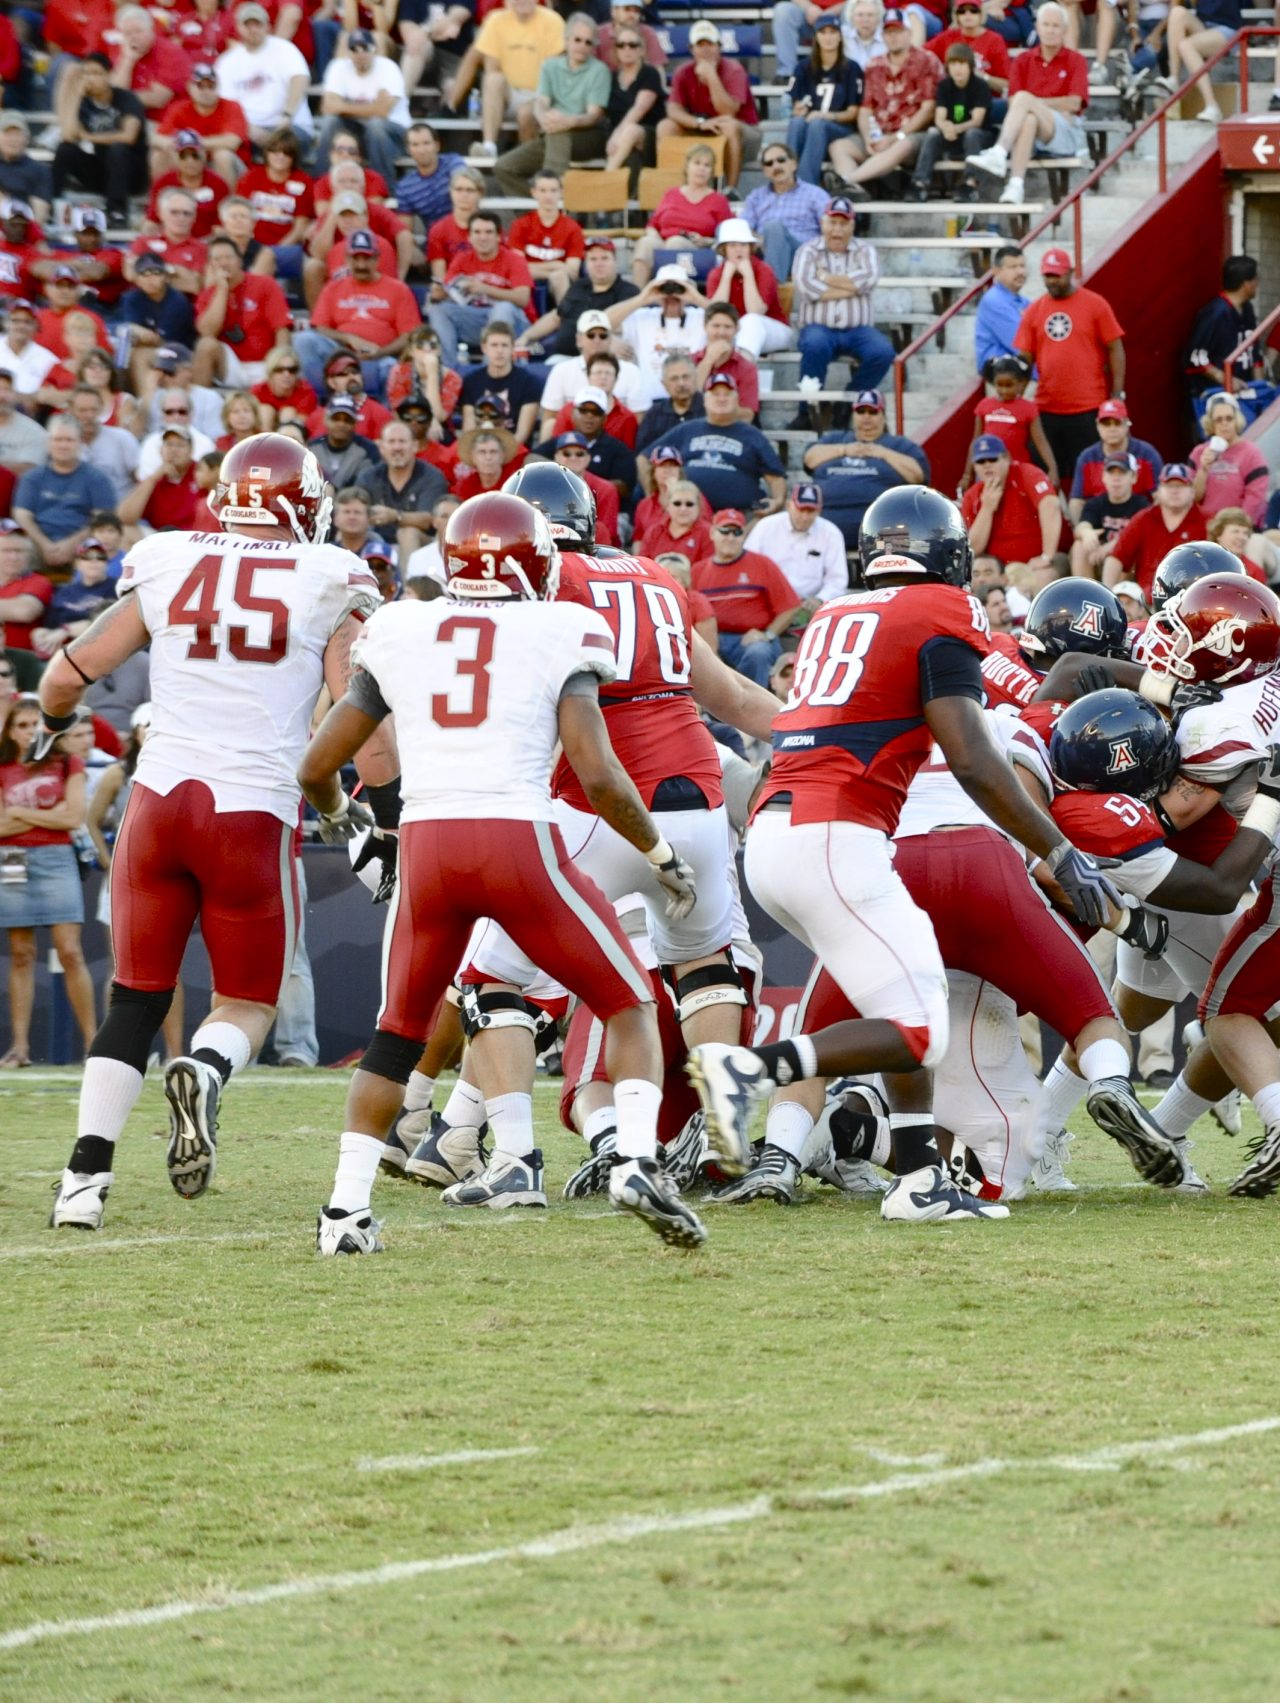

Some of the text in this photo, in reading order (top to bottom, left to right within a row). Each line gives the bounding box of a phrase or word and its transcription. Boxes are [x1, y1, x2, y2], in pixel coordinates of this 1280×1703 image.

[816, 82, 836, 113] 7
[230, 510, 257, 519] COUGARS
[480, 553, 496, 579] 3
[873, 559, 908, 569] ARIZONA
[459, 583, 488, 591] COUGARS
[168, 554, 299, 665] 45
[1069, 600, 1104, 640] A
[588, 580, 690, 684] 78
[431, 615, 498, 730] 3
[779, 612, 881, 713] 88
[781, 733, 816, 749] ARIZONA
[1106, 737, 1140, 775] A
